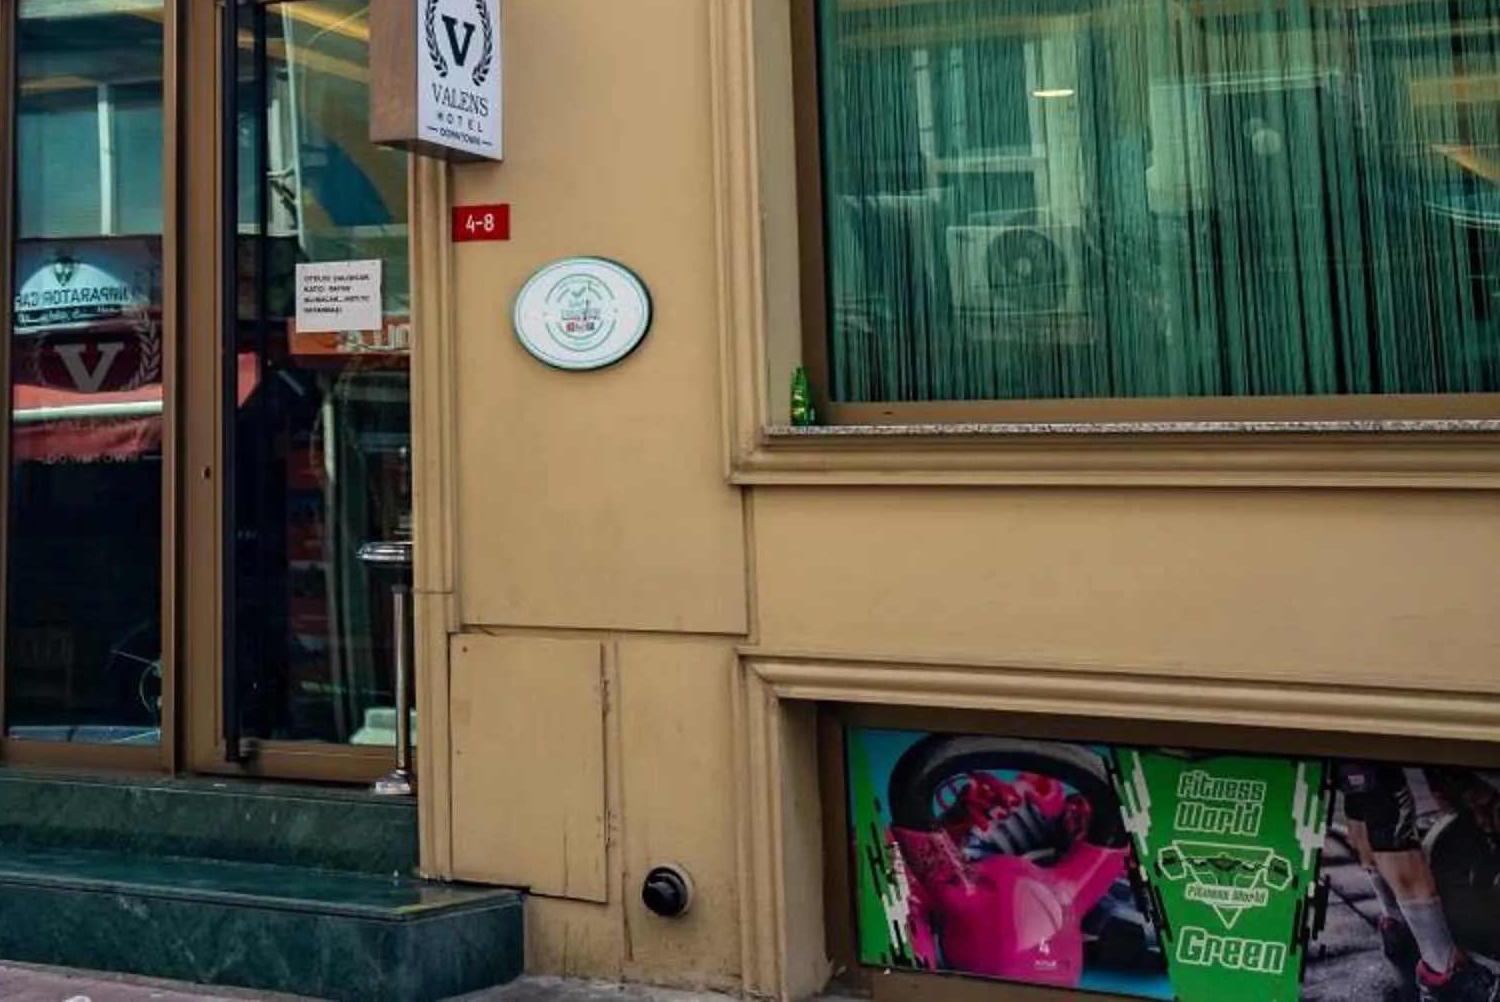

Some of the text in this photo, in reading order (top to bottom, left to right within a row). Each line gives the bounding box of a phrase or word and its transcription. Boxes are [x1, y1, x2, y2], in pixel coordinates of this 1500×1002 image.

[441, 14, 475, 67] V
[432, 83, 488, 117] VALENS
[437, 112, 483, 133] HOTEL
[440, 127, 481, 146] DOWNTOWN
[465, 213, 495, 233] 4-8
[54, 342, 125, 393] V
[1177, 769, 1267, 801] Fitness
[1174, 801, 1263, 837] World
[1176, 926, 1286, 974] Green
